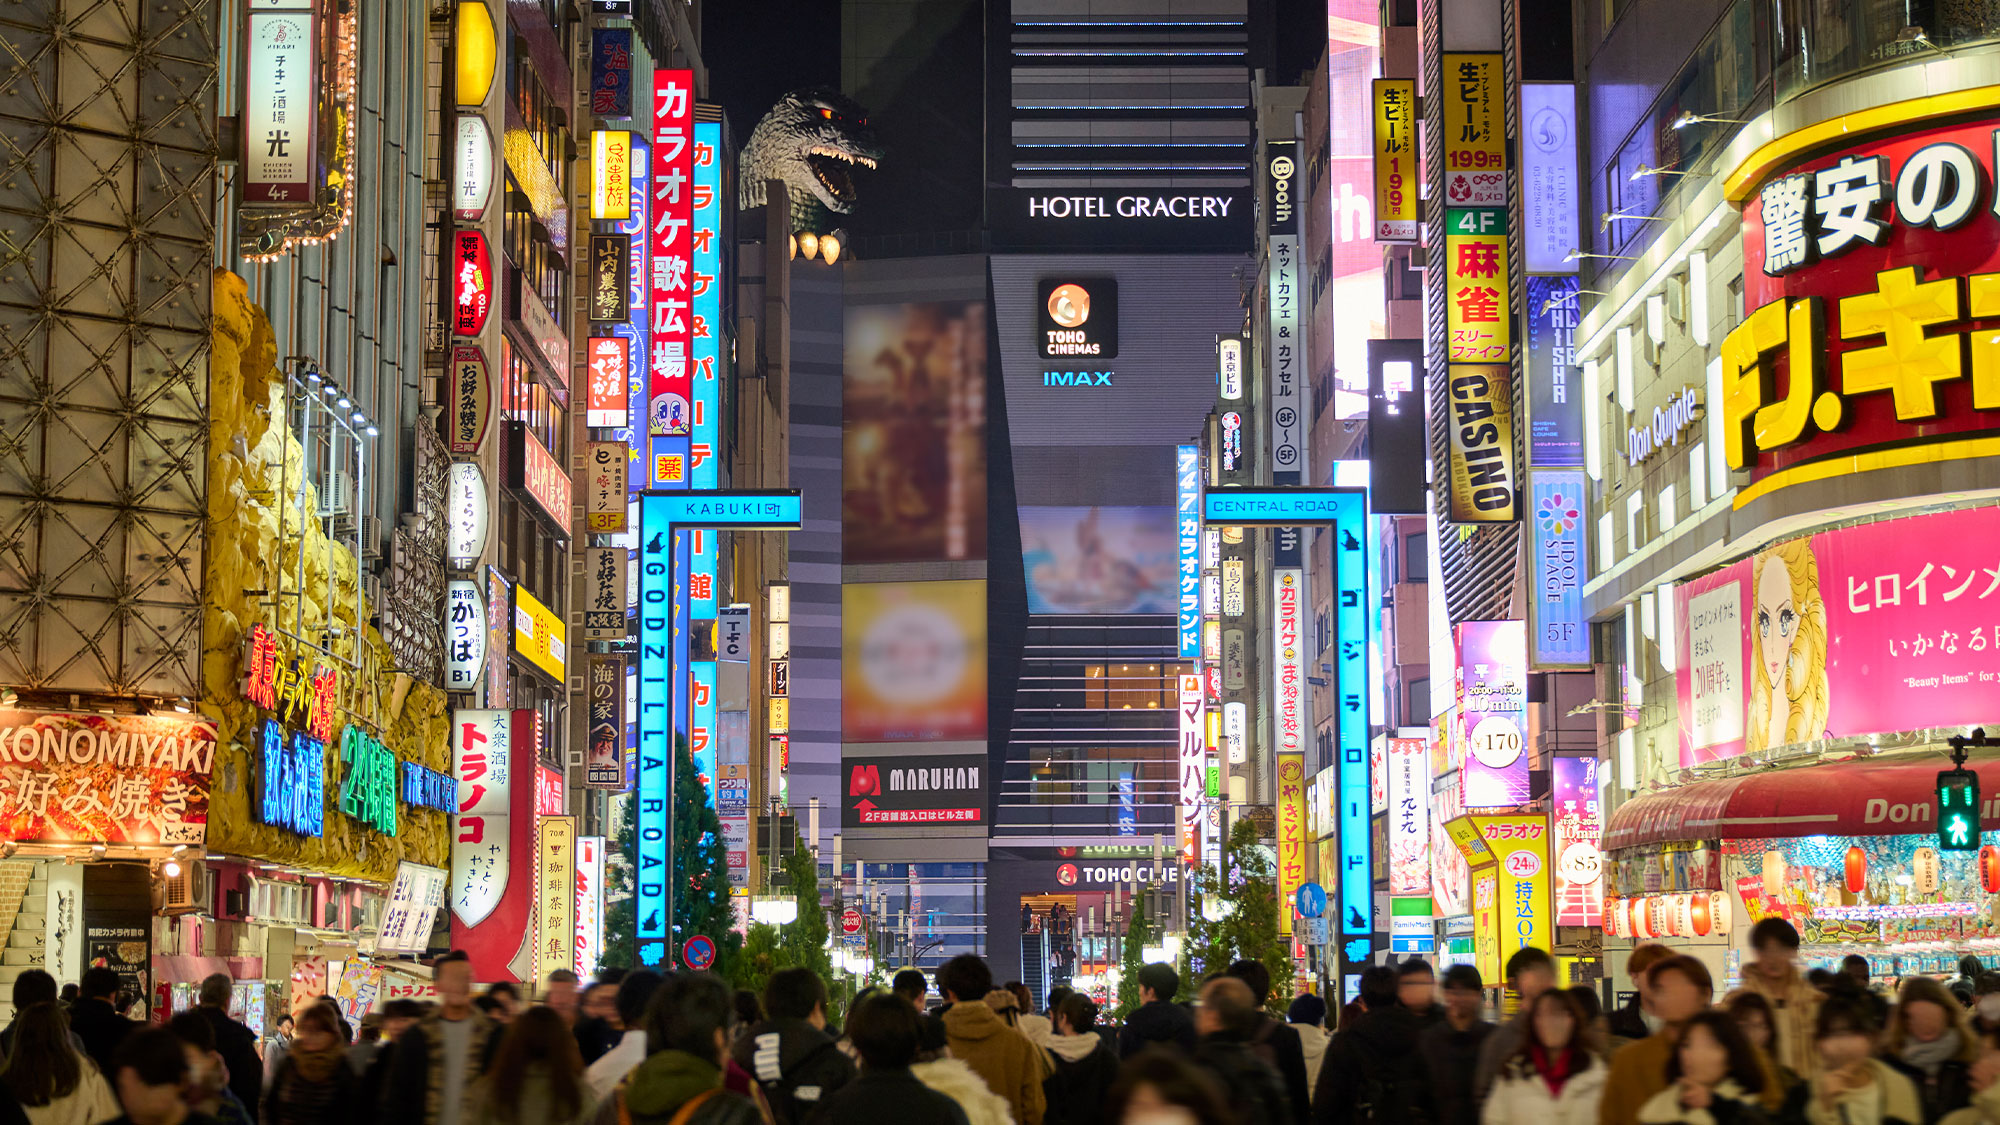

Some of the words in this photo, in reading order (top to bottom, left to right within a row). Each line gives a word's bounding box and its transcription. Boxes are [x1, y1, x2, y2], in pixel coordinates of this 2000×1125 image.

[605, 2, 617, 10] 8F
[273, 55, 287, 124] チキン酒場
[1458, 63, 1480, 143] 生ビール
[1383, 88, 1402, 154] 生ビール
[266, 130, 290, 157] 光
[1449, 150, 1502, 168] 199円
[268, 184, 289, 200] 4F
[463, 181, 477, 196] 光
[607, 143, 624, 206] 鳥貴族
[1270, 156, 1295, 222] Booth
[1389, 157, 1403, 216] 199円
[1030, 197, 1110, 217] HOTEL
[1116, 196, 1232, 218] GRACERY
[1760, 130, 2000, 277] 驚安の
[653, 82, 688, 378] カラオケ歌広場
[1458, 212, 1495, 233] 4F
[596, 239, 620, 309] 山内農場
[1277, 243, 1291, 319] ネットカフェ
[1456, 242, 1501, 323] 麻雀
[478, 294, 487, 317] 3F
[602, 309, 614, 318] 5F
[1047, 331, 1086, 343] TOHO
[1047, 343, 1100, 355] CINEMAS
[1279, 326, 1290, 338] &
[1452, 329, 1493, 343] スリー
[1551, 290, 1566, 404] SHISHA
[1452, 345, 1507, 358] ファイブ
[692, 142, 715, 600] カラオケ&パーテー館
[1043, 372, 1113, 386] IMAX
[1226, 351, 1237, 394] 東京ビル
[1279, 345, 1292, 397] カプセル
[460, 365, 478, 442] お好み焼き
[1451, 374, 1512, 513] CASINO
[1628, 426, 1653, 468] Don
[1653, 385, 1698, 449] Quijote
[453, 443, 476, 452] 2階
[532, 443, 566, 523] 山内農場
[658, 458, 681, 480] 薬
[460, 485, 476, 553] とらそば
[597, 514, 617, 527] 3F
[686, 503, 782, 517] KABUKI町
[1214, 501, 1288, 511] CENTRAL
[1295, 501, 1338, 511] ROAD
[455, 558, 472, 569] 1F
[595, 550, 617, 610] お好み焼
[1546, 540, 1561, 603] STAGE
[1561, 540, 1576, 592] IDOL
[452, 590, 474, 599] 新宿
[1847, 562, 2000, 613] ヒロインメ
[451, 601, 474, 663] かっぱ
[587, 613, 622, 628] 大阪家
[1281, 587, 1297, 647] カラオケ
[1548, 623, 1576, 641] 5F
[726, 621, 740, 655] TFC
[453, 671, 472, 682] B1
[643, 562, 665, 771] GODZILLA
[1903, 676, 1940, 689] “Beauty
[1942, 672, 1974, 685] Items”
[1979, 671, 1995, 682] for
[594, 664, 614, 720] 海の家
[1281, 663, 1298, 749] まねきねこ
[1341, 588, 1363, 871] ゴジラロード
[491, 714, 508, 785] 大衆酒場
[1182, 699, 1202, 823] マルハン
[458, 722, 488, 845] トラノコ
[719, 779, 746, 788] つり具
[722, 790, 745, 798] 釣具
[890, 767, 979, 791] MARUHAN
[865, 810, 974, 822] 2F店舗出入口はビル左側
[1401, 797, 1418, 834] 九十九
[1864, 799, 1930, 823] Don
[642, 799, 664, 897] ROAD
[1485, 823, 1544, 840] カラオケ
[480, 845, 501, 896] やきとり
[1083, 867, 1133, 883] TOHO
[1512, 856, 1535, 871] 24H
[460, 856, 482, 908] やきとん
[548, 862, 564, 928] 珈琲茶館
[1394, 921, 1431, 929] FamilyMart
[1906, 931, 1938, 941] JAPAN
[545, 938, 566, 961] 集
